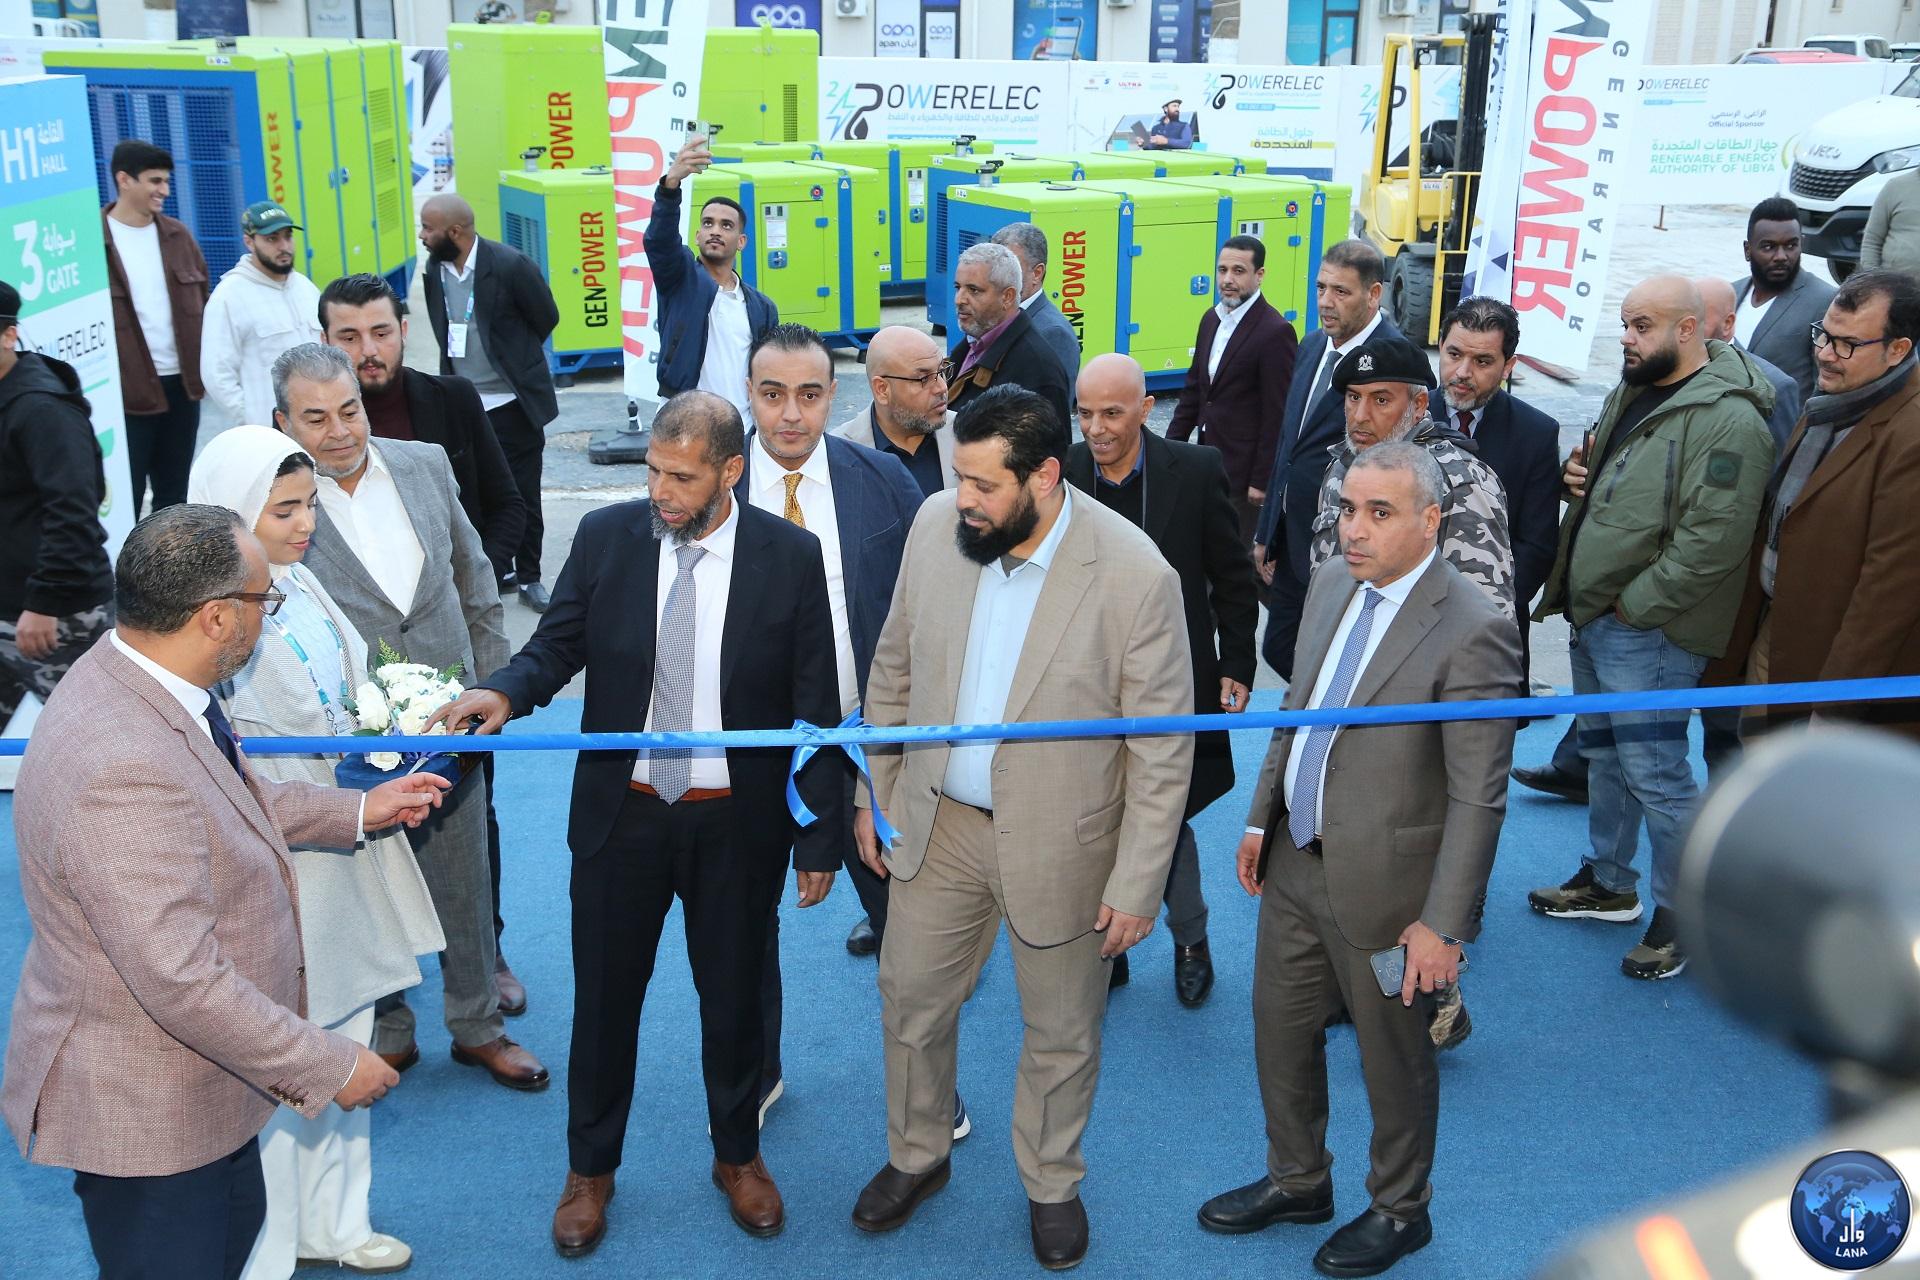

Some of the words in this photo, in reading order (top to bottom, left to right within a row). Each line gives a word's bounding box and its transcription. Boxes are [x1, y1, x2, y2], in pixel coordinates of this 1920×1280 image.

[0, 127, 39, 184] H1
[1753, 137, 1778, 152] جهاز
[41, 153, 68, 175] HALL
[1650, 164, 1716, 174] AUTHORITY
[1721, 164, 1736, 173] OF
[1743, 164, 1775, 173] LIBYA
[1651, 154, 1724, 164] RENEWABLE
[1729, 153, 1777, 163] ENERGY
[13, 220, 43, 301] 3
[580, 211, 608, 328] GENPOWER
[46, 262, 80, 294] GATE
